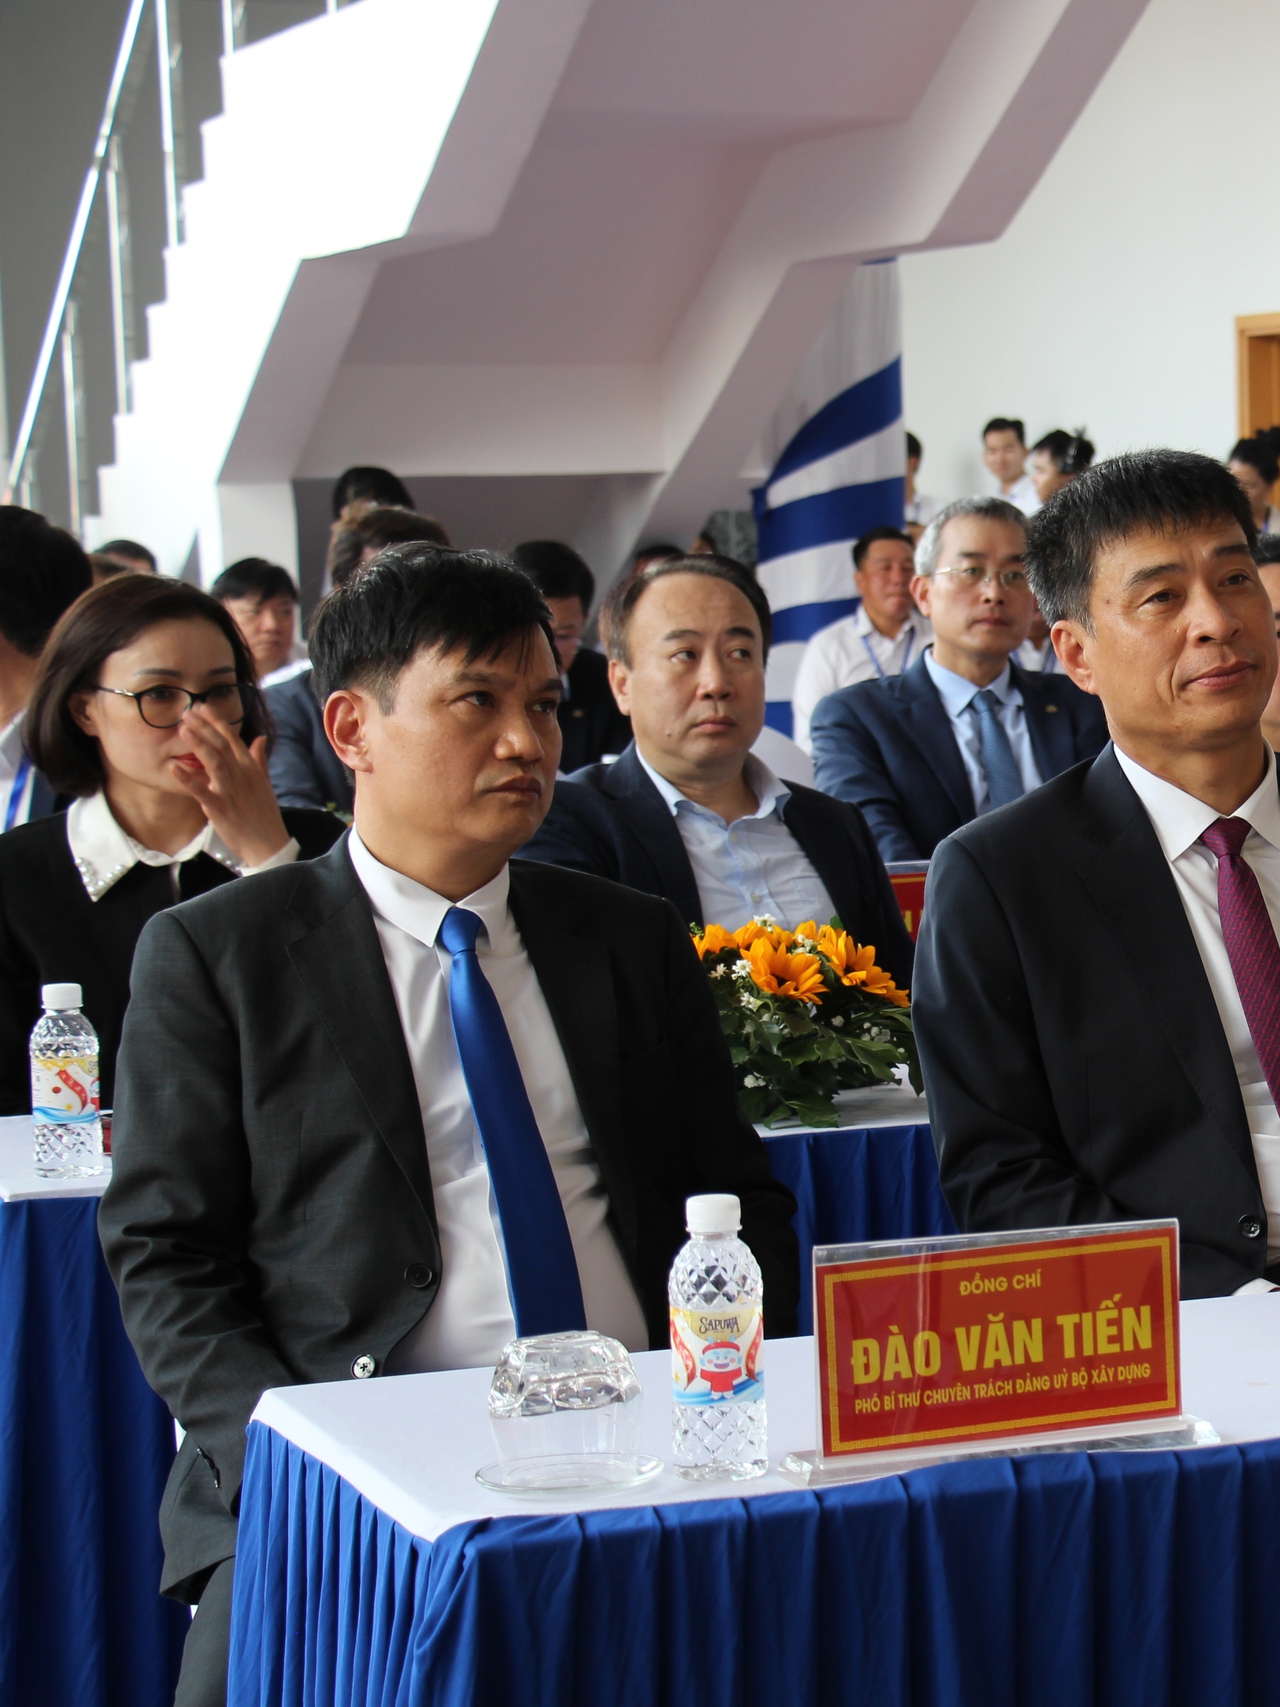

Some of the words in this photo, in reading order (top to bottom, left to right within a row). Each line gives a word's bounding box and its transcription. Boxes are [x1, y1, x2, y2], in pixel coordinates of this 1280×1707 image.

[960, 1272, 1008, 1296] ĐỒNG
[1013, 1268, 1042, 1289] CHÍ
[699, 1316, 740, 1334] SAPUWA
[851, 1325, 941, 1385] ĐÀO
[955, 1312, 1044, 1372] VĂN
[1056, 1293, 1152, 1359] TIẾN
[855, 1393, 881, 1414] PHÓ
[884, 1390, 896, 1410] BÍ
[897, 1390, 921, 1408] THƯ
[923, 1382, 971, 1405] CHUYÊN
[974, 1378, 1013, 1398] TRÁCH
[1015, 1372, 1050, 1394] ĐẢNG
[1053, 1368, 1068, 1389] UỶ
[1071, 1367, 1088, 1389] BỘ
[1091, 1364, 1115, 1384] XÂY
[1118, 1363, 1151, 1384] DỰNG
